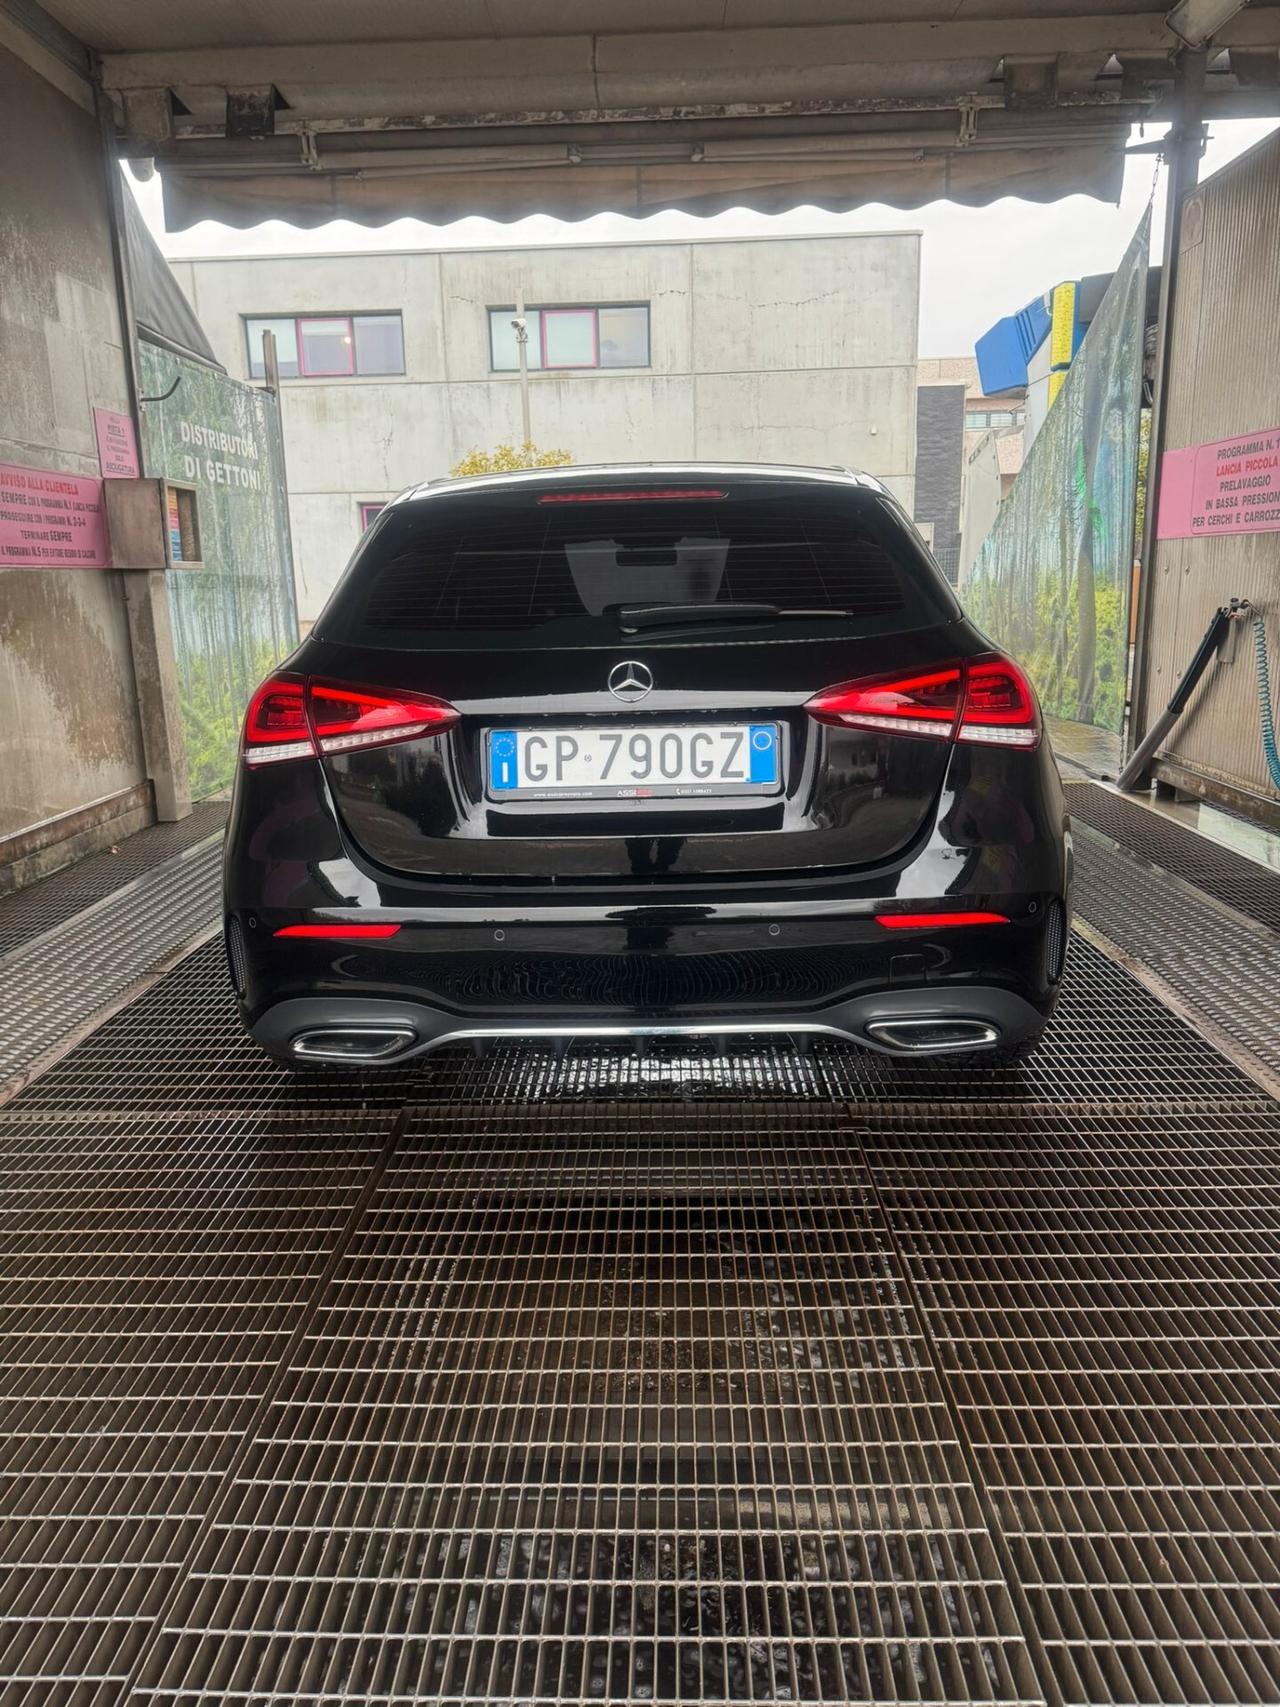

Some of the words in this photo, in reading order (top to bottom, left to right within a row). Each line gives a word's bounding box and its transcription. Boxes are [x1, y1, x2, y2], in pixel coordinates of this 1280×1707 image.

[180, 421, 258, 460] DISTRIBUTORI
[1217, 442, 1264, 460] PROGRAMMA
[1266, 440, 1275, 450] N.
[184, 455, 200, 479] DI
[206, 459, 261, 490] GETTONI
[1216, 462, 1242, 477] LANCIA
[1245, 456, 1278, 472] PICCOLA
[28, 477, 44, 491] ALLA
[45, 480, 79, 496] CLIENTELA
[1219, 474, 1272, 492] PRELAVAGGIO
[1, 491, 27, 505] SEMPRE
[1205, 500, 1213, 510] IN
[1215, 497, 1238, 509] BASSA
[1192, 517, 1205, 527] PER
[1208, 513, 1233, 526] CERCHI
[1235, 512, 1241, 523] E
[49, 530, 72, 542] SEMPRE
